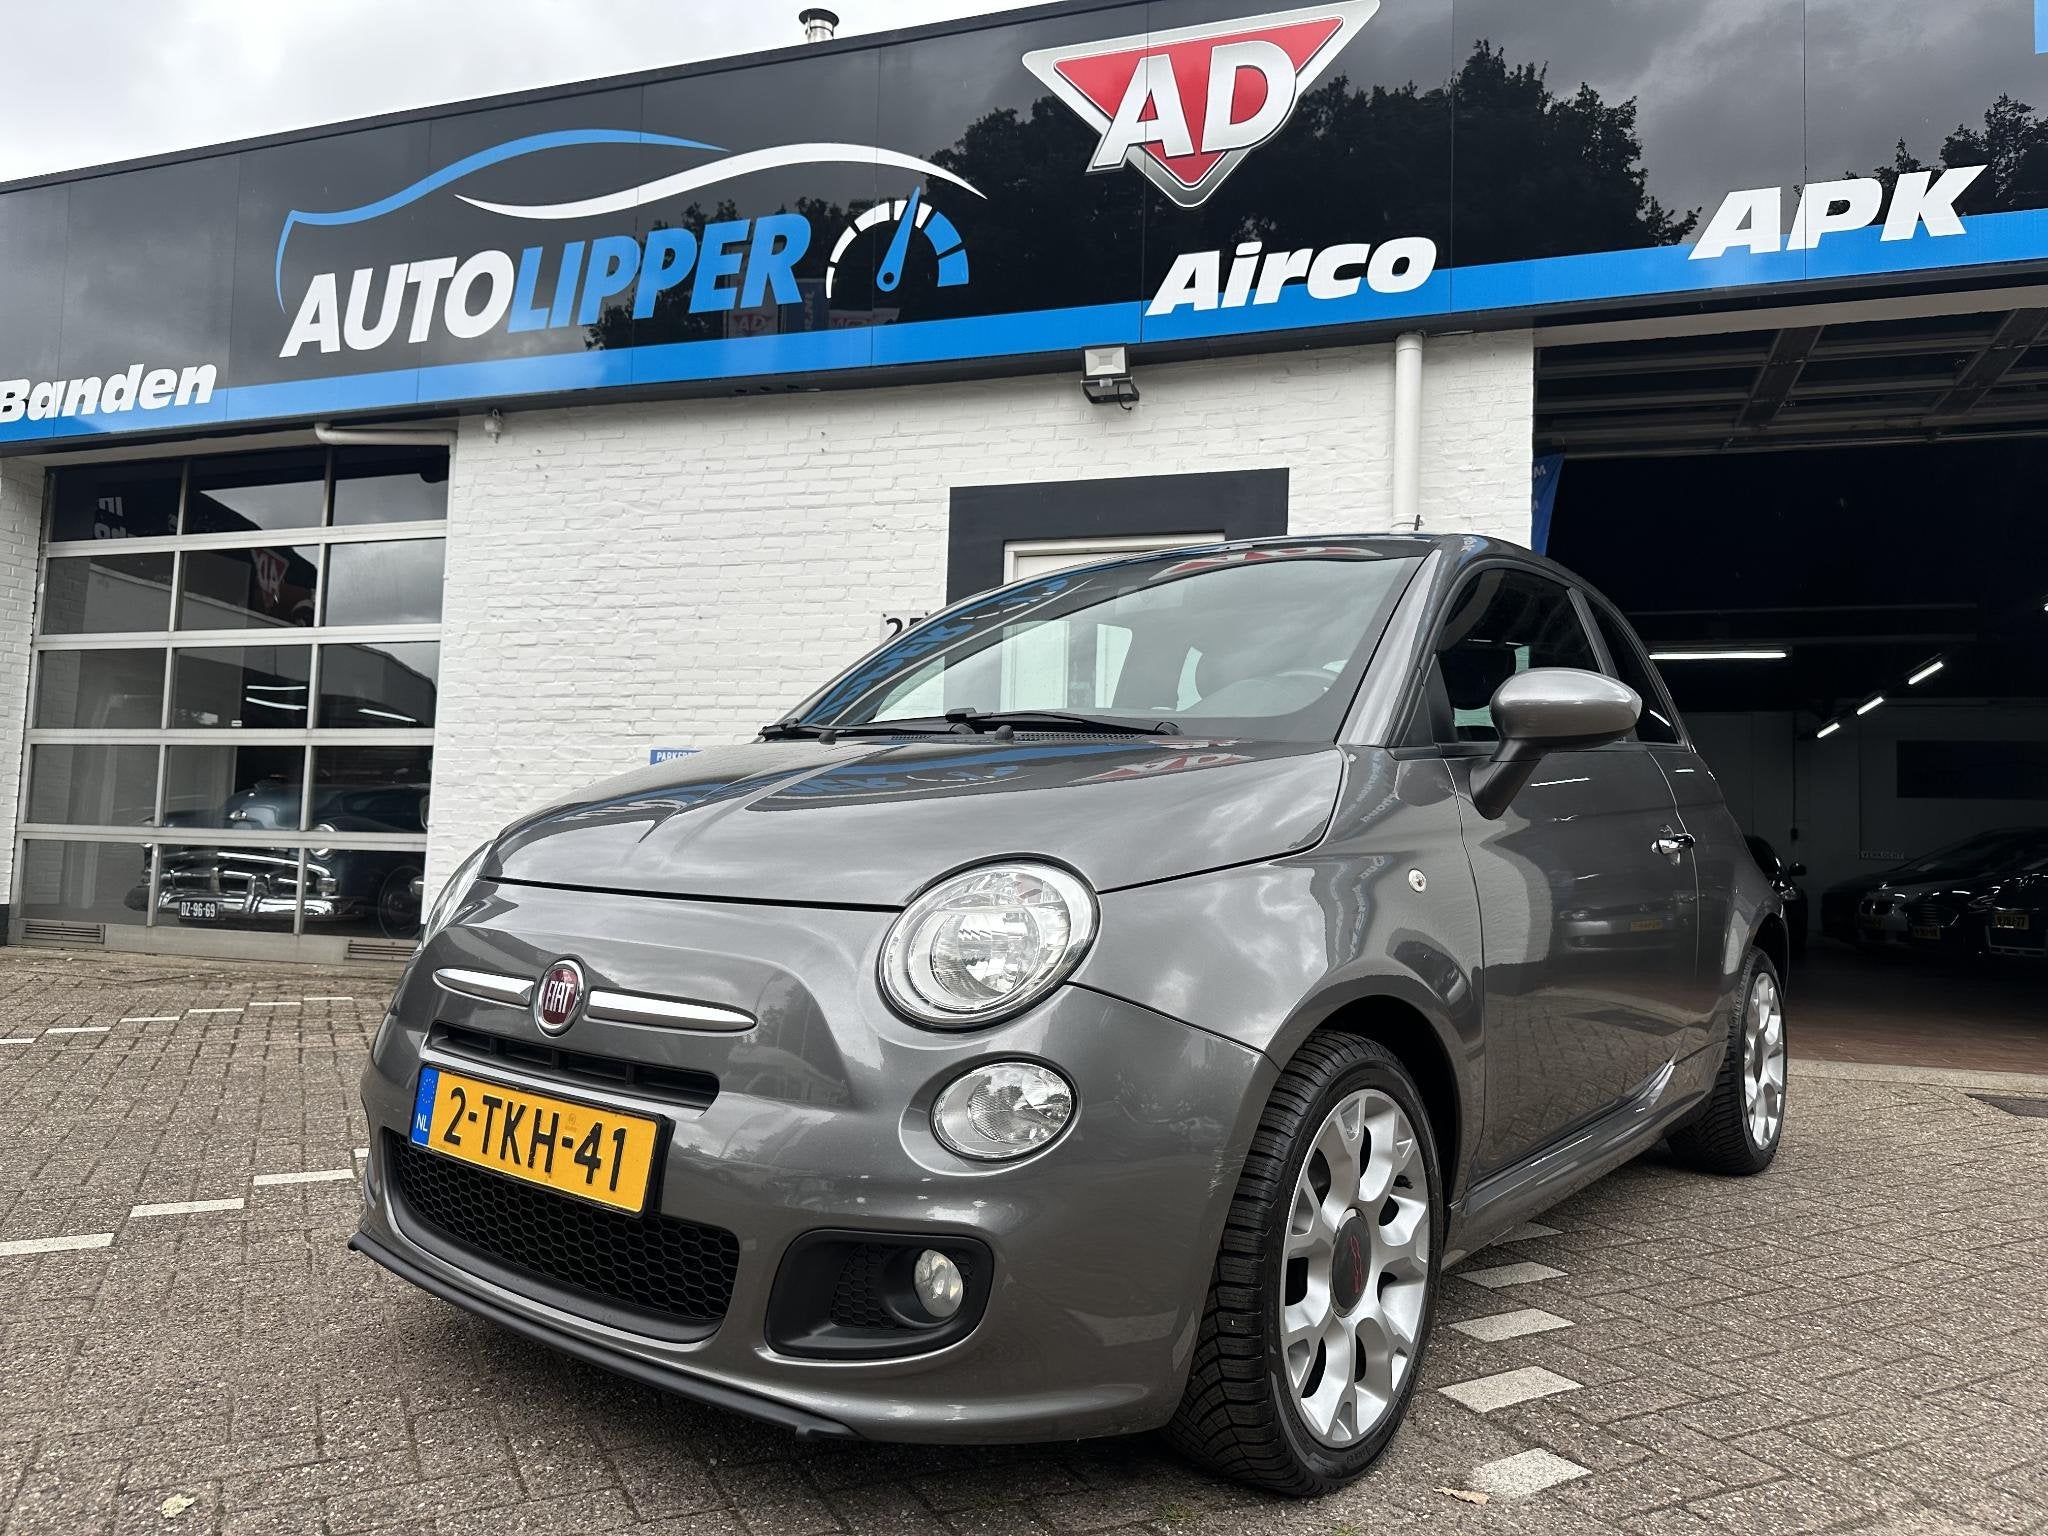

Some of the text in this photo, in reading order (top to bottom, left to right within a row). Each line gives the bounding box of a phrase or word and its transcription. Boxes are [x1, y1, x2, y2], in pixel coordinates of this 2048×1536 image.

[1093, 40, 1297, 168] AD
[1688, 165, 1988, 260] APK
[279, 213, 811, 358] AUTOLIPPER
[1144, 236, 1437, 317] Airco
[0, 363, 217, 423] Banden
[886, 617, 925, 640] 2
[181, 901, 216, 917] DZ-96-69
[545, 980, 575, 1013] FIAT
[416, 1112, 428, 1133] NL
[443, 1086, 627, 1191] 2-TKH-41
